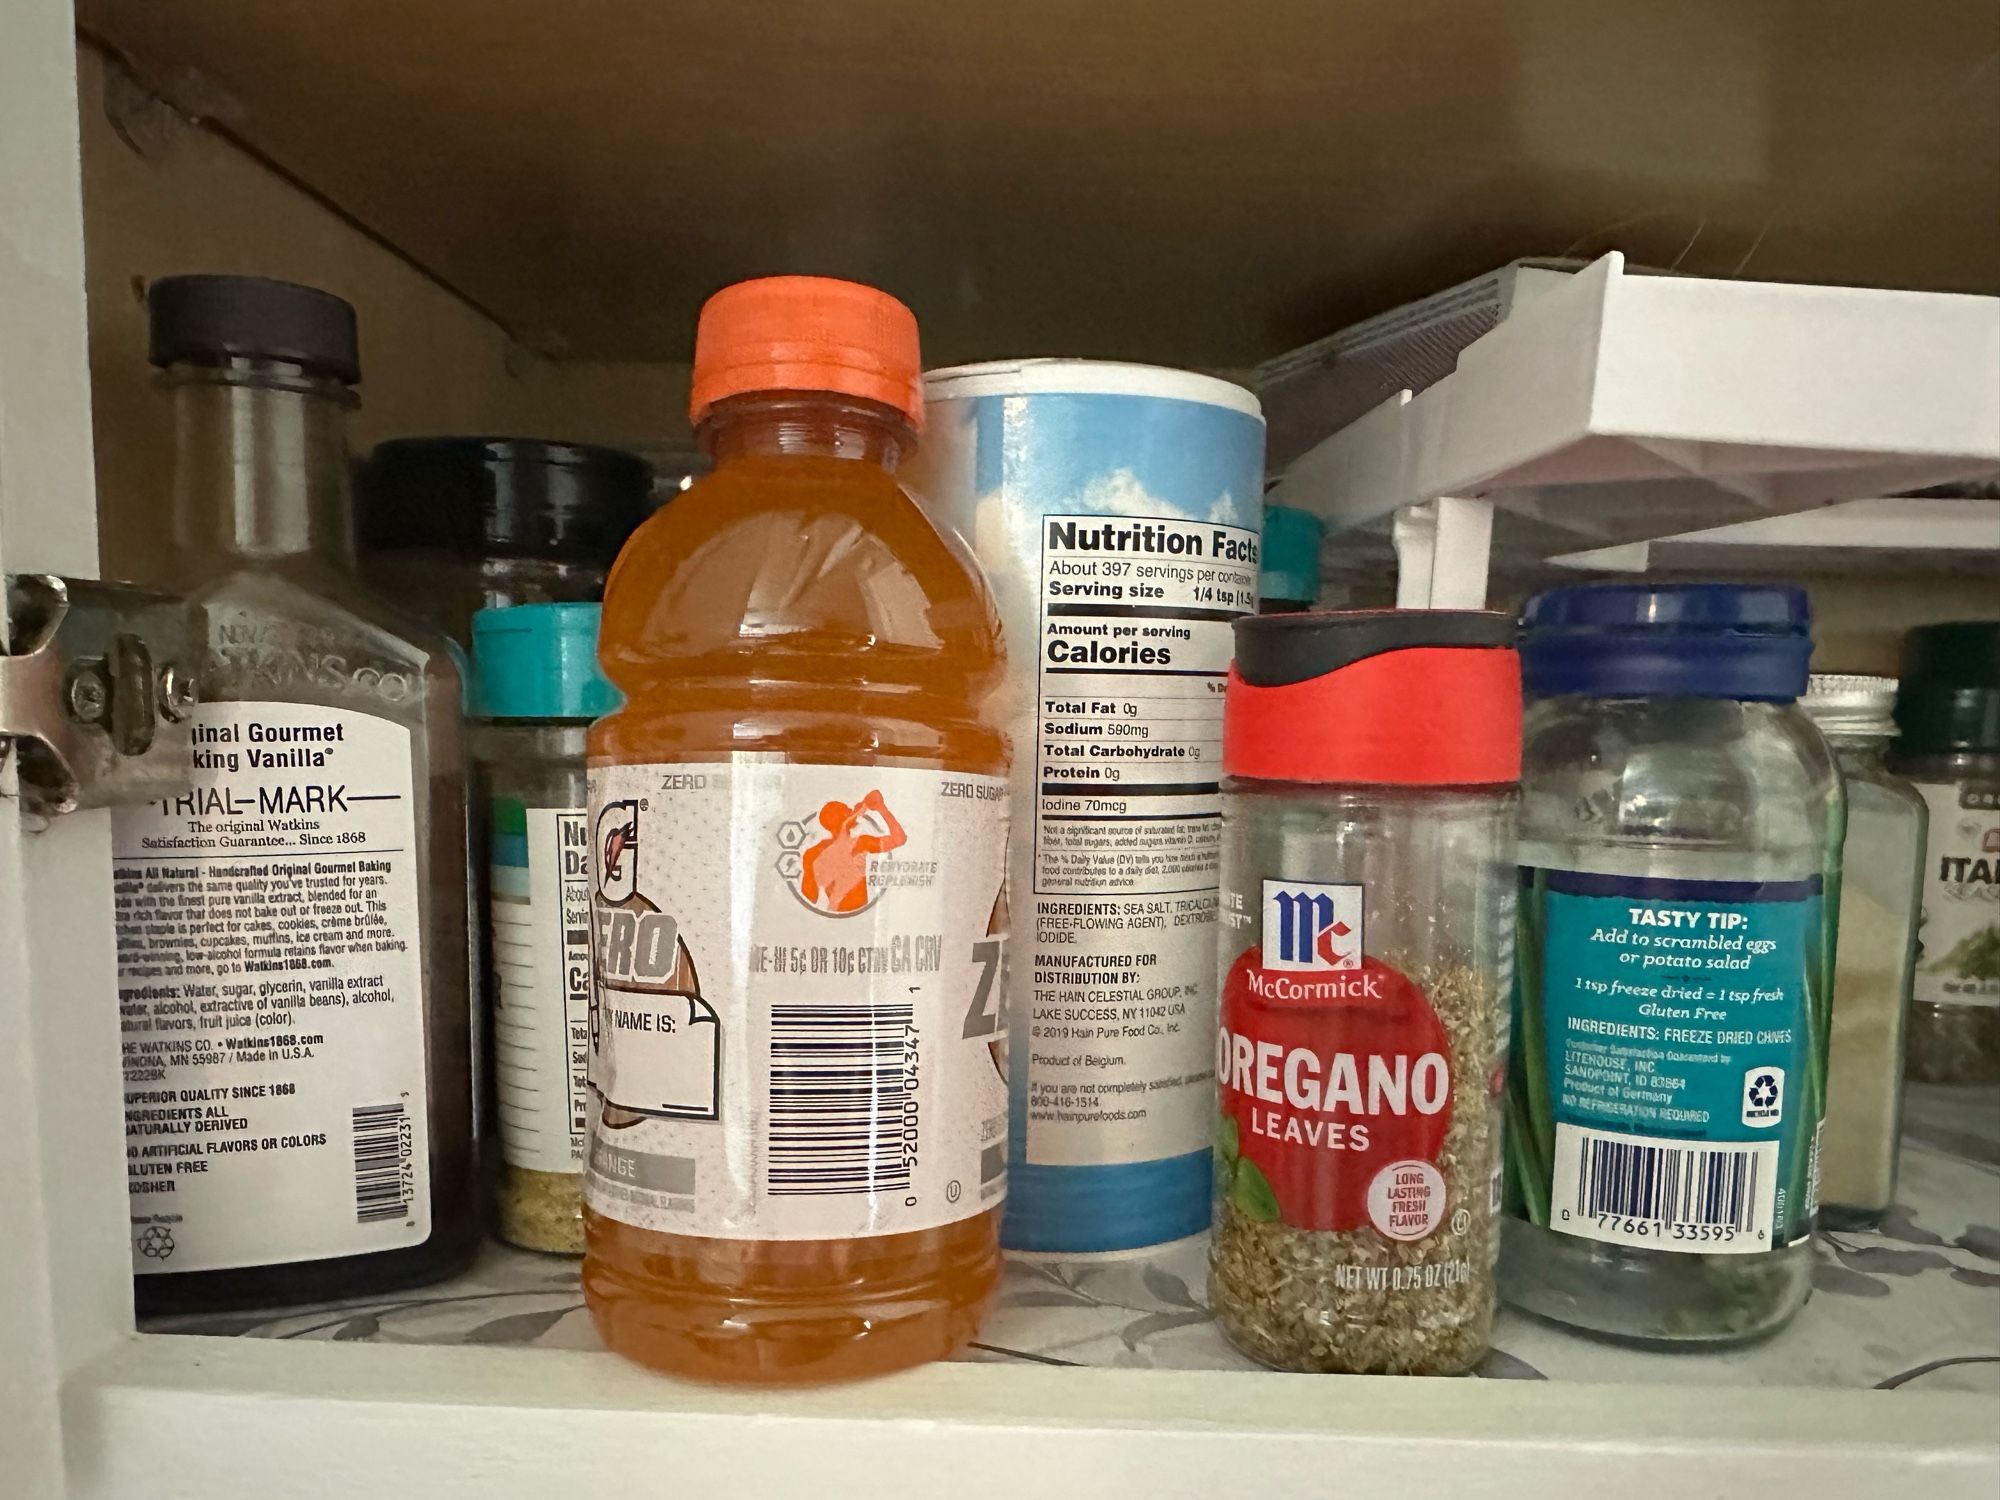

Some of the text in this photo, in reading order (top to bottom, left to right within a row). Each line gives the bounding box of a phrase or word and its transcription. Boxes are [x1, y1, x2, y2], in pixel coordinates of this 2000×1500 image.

[1049, 522, 1258, 564] Nutrition Facts
[1049, 560, 1097, 576] About
[1102, 562, 1131, 577] 397
[1136, 564, 1194, 583] servings
[1197, 568, 1216, 586] per
[1049, 581, 1233, 606] Serving size 1/4 tsp
[1047, 623, 1191, 640] Amount per serving
[1047, 639, 1171, 665] Calories
[1045, 701, 1138, 718] Total Fat 0g
[249, 723, 344, 742] Gourmet
[1044, 723, 1149, 739] Sodium 590mg
[193, 749, 239, 772] king
[1044, 743, 1200, 760] Total Carbohydrate 0g
[661, 774, 708, 790] ZERO
[1043, 766, 1120, 781] Protein 0g
[941, 781, 974, 798] ZERO
[1041, 798, 1127, 814] Iodine 70mcg
[187, 819, 320, 835] The original Watkins
[142, 836, 216, 850] Satisfaction
[299, 832, 333, 846] Since
[336, 831, 367, 845] 1868
[145, 867, 160, 879] All
[162, 866, 199, 879] Natural
[209, 864, 269, 878] Handcrafted
[272, 862, 311, 880] Original
[314, 860, 356, 876] Gourmet
[359, 859, 391, 875] Baking
[1037, 902, 1121, 916] INGREDIENTS:
[1123, 903, 1145, 915] SEA
[1036, 916, 1124, 930] (FREE-FLOWING
[1629, 908, 1748, 930] TASTY TIP:
[1590, 928, 1777, 955] Add to scrambled eggs
[811, 945, 828, 974] OR
[1034, 954, 1157, 967] MANUFACTURED FOR
[1619, 952, 1751, 970] or potato salad
[1034, 971, 1141, 985] DISTRIBUTION BY:
[1247, 969, 1383, 1000] McCormick
[1034, 989, 1056, 1002] THE
[1059, 989, 1086, 1002] HAIN
[1088, 989, 1144, 1002] CELESTIAL
[1575, 977, 1785, 1005] 1 tsp freeze dried 1 tsp fresh
[1033, 1007, 1062, 1020] LAKE
[1122, 1007, 1137, 1020] NY
[1139, 1006, 1166, 1019] 11042
[1168, 1003, 1186, 1016] USA
[1638, 1002, 1727, 1021] Gluten Free
[614, 1010, 676, 1034] NAME IS:
[1567, 1016, 1660, 1041] INGREDIENTS:
[1664, 1027, 1714, 1045] FREEZE
[1717, 1029, 1753, 1045] DRIED
[1043, 1026, 1069, 1038] 2019
[1071, 1026, 1094, 1039] Hain
[1096, 1026, 1120, 1039] Pure
[1122, 1025, 1145, 1037] Food
[140, 1040, 193, 1053] WATKINS
[225, 1033, 324, 1050] Watkins1868.com
[904, 1024, 921, 1091] 04347
[1032, 1053, 1070, 1066] Product
[1072, 1053, 1082, 1065] of
[1217, 1026, 1450, 1116] OREGANO
[180, 1083, 296, 1102] QUALITY SINCE 1868
[205, 1105, 229, 1118] ALL
[194, 1117, 248, 1133] DERIVED
[903, 1099, 920, 1168] 52000
[1252, 1107, 1371, 1152] LEAVES
[141, 1133, 327, 1158] ARTIFICIAL FLAVORS OR COLORS
[176, 1160, 209, 1174] FREE
[1395, 1172, 1424, 1185] LONG
[1387, 1185, 1431, 1200] LASTING
[1391, 1200, 1427, 1213] FRESH
[1389, 1213, 1429, 1228] FLAVOR
[1597, 1213, 1661, 1238] 77661
[1673, 1223, 1735, 1241] 33595
[1335, 1264, 1361, 1289] NET
[1365, 1265, 1389, 1290] WT
[1392, 1264, 1422, 1291] 0.75
[1425, 1263, 1441, 1287] OZ
